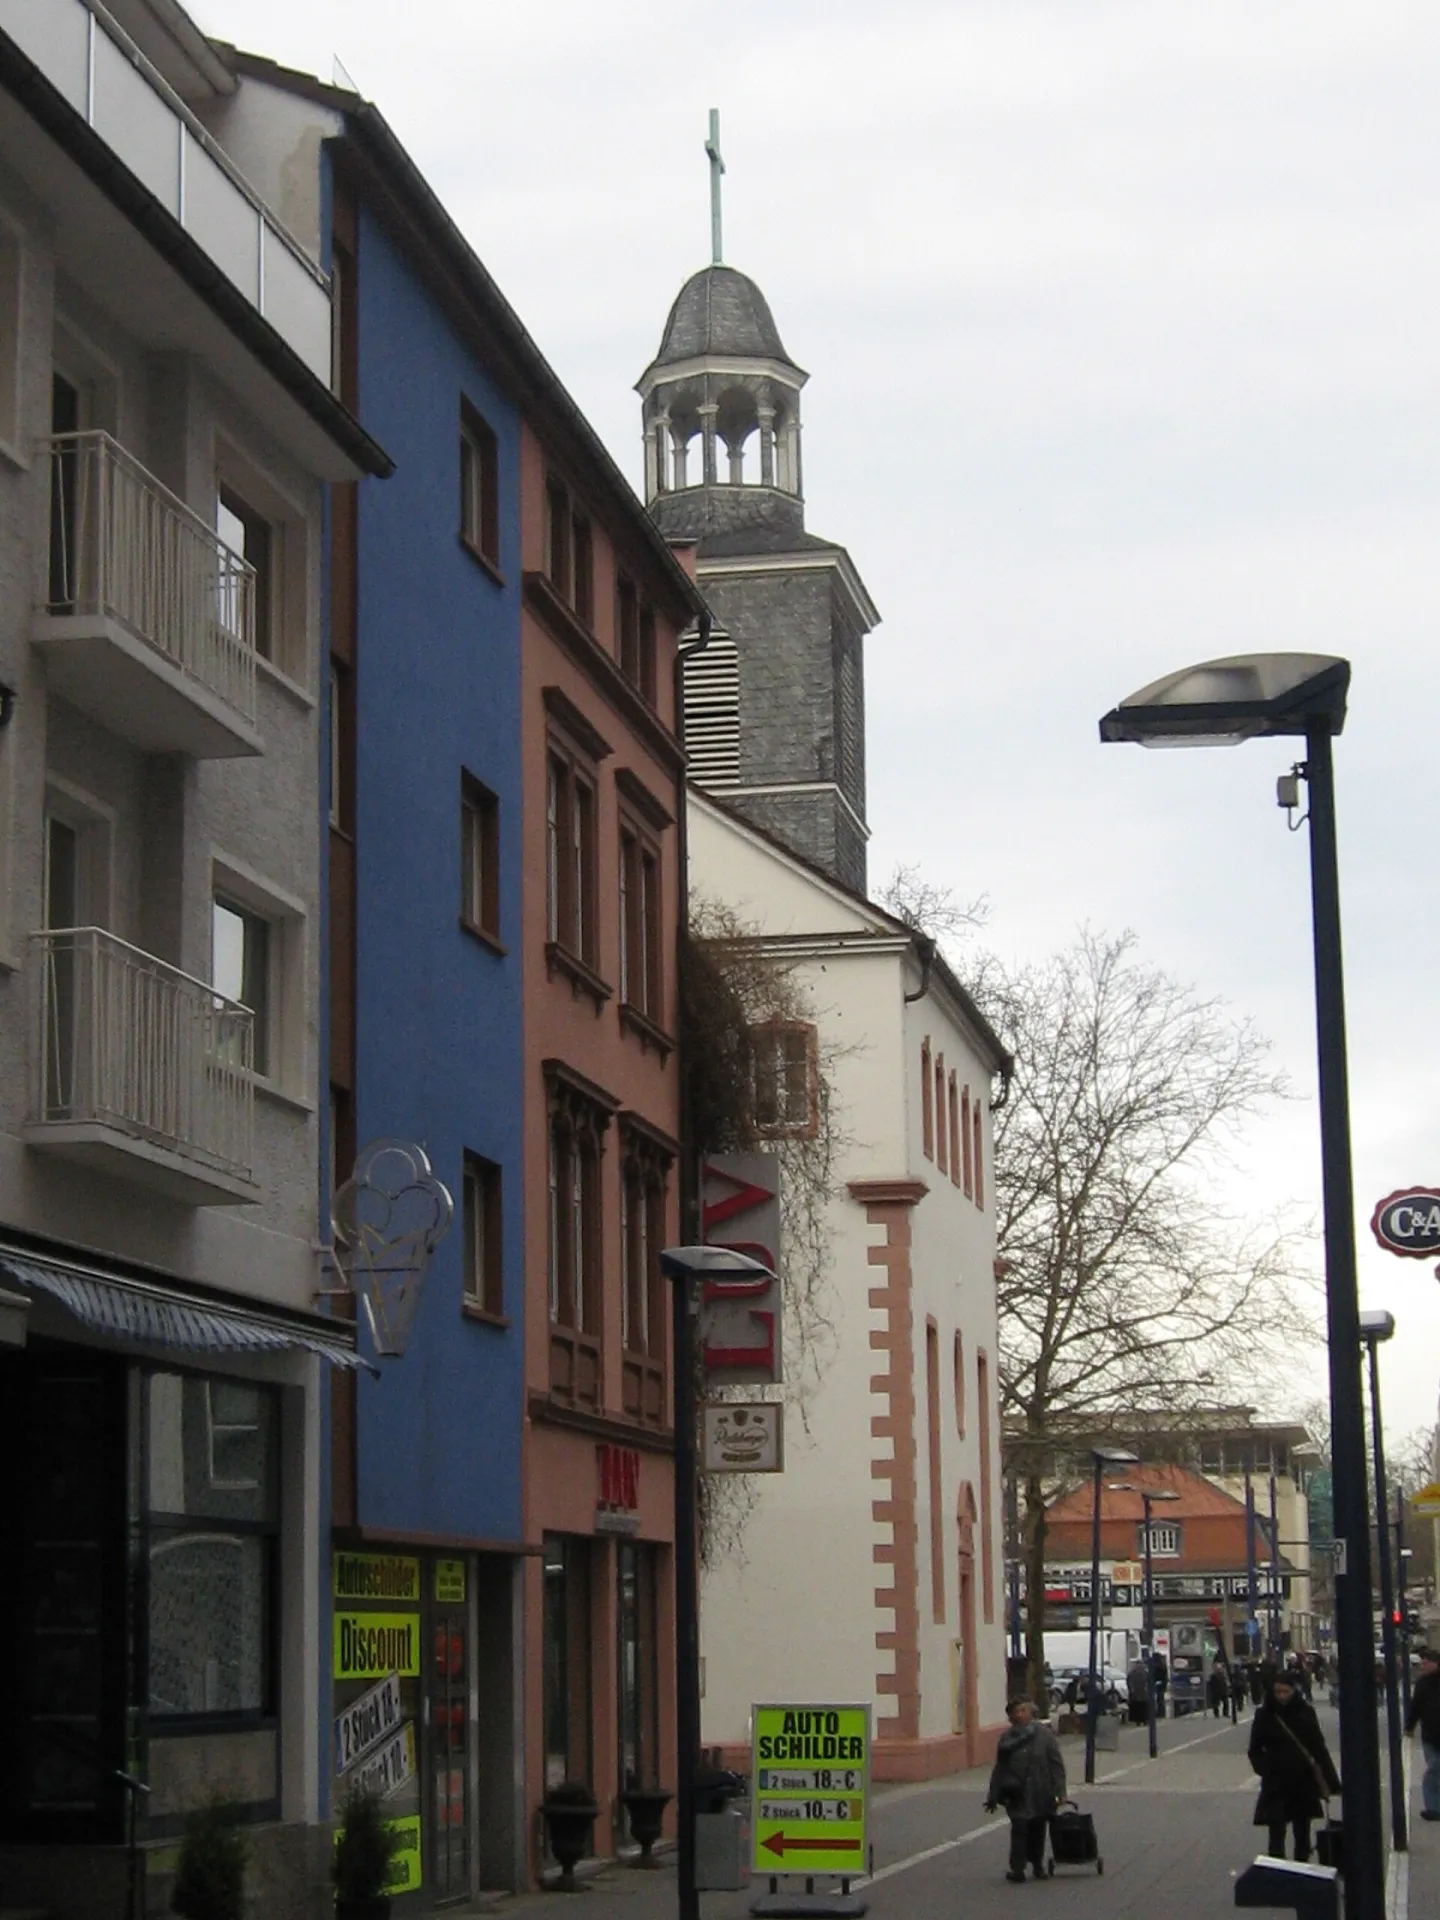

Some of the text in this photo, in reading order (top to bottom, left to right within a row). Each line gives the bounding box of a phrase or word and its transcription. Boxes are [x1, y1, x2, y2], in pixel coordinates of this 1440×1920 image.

[1390, 1205, 1440, 1238] C&A
[340, 1618, 412, 1672] Discount
[783, 1711, 840, 1735] AUTO
[342, 1718, 351, 1761] 2
[760, 1736, 862, 1759] SCHILDER
[771, 1775, 779, 1789] 2
[762, 1804, 770, 1818] 2
